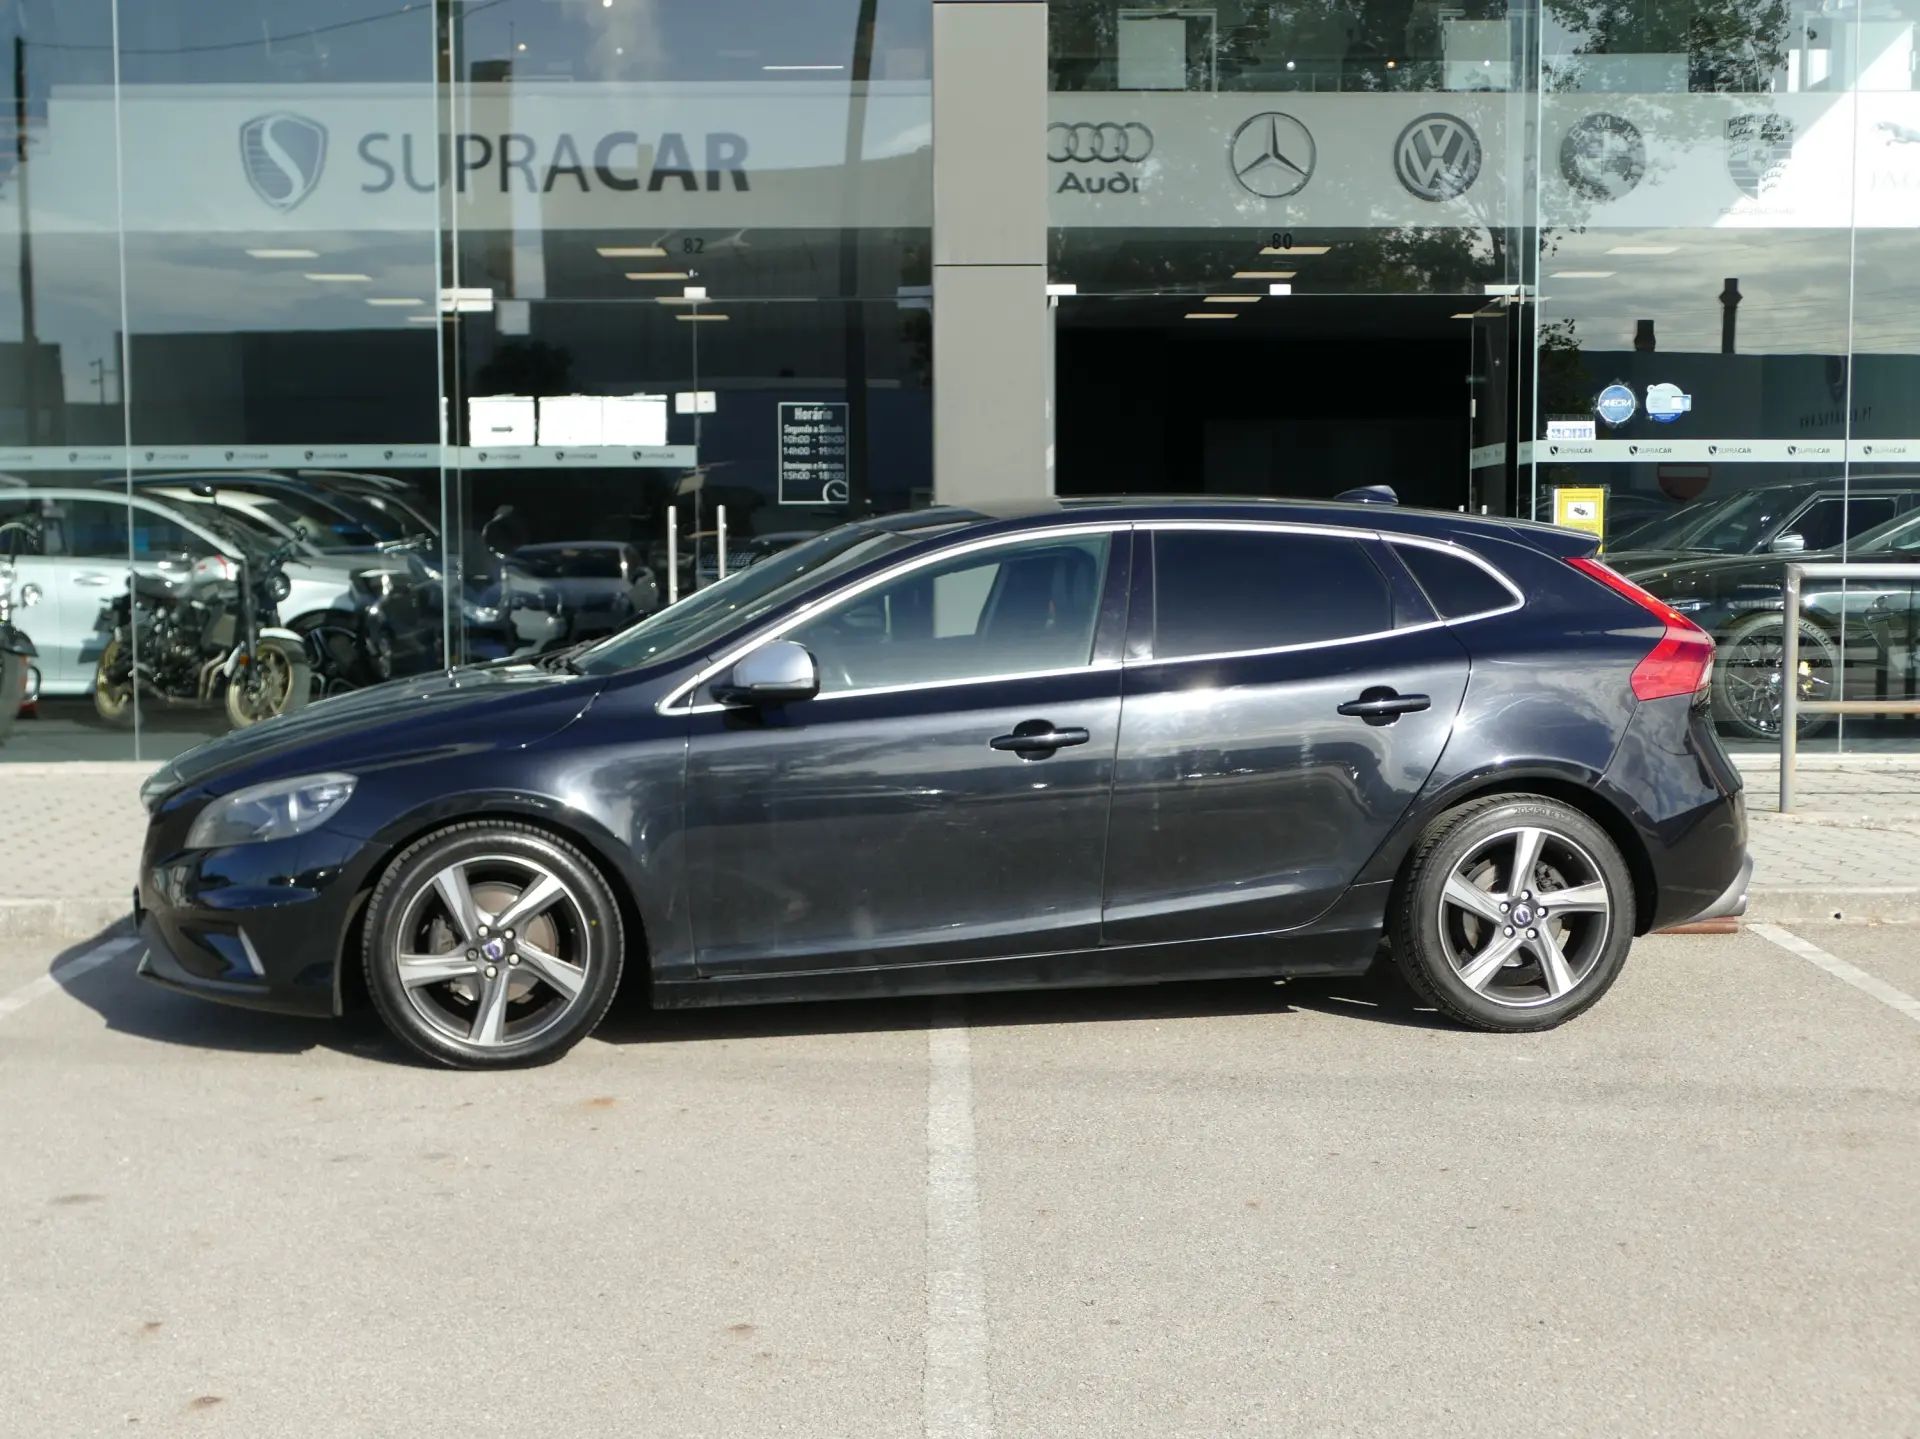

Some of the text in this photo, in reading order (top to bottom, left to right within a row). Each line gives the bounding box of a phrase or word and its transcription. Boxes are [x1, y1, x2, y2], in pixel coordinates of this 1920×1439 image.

[356, 131, 751, 194] SUPRACAR
[1056, 171, 1140, 194] Audi
[683, 237, 704, 255] 82
[1272, 232, 1293, 250] 80
[794, 406, 834, 421] Horário
